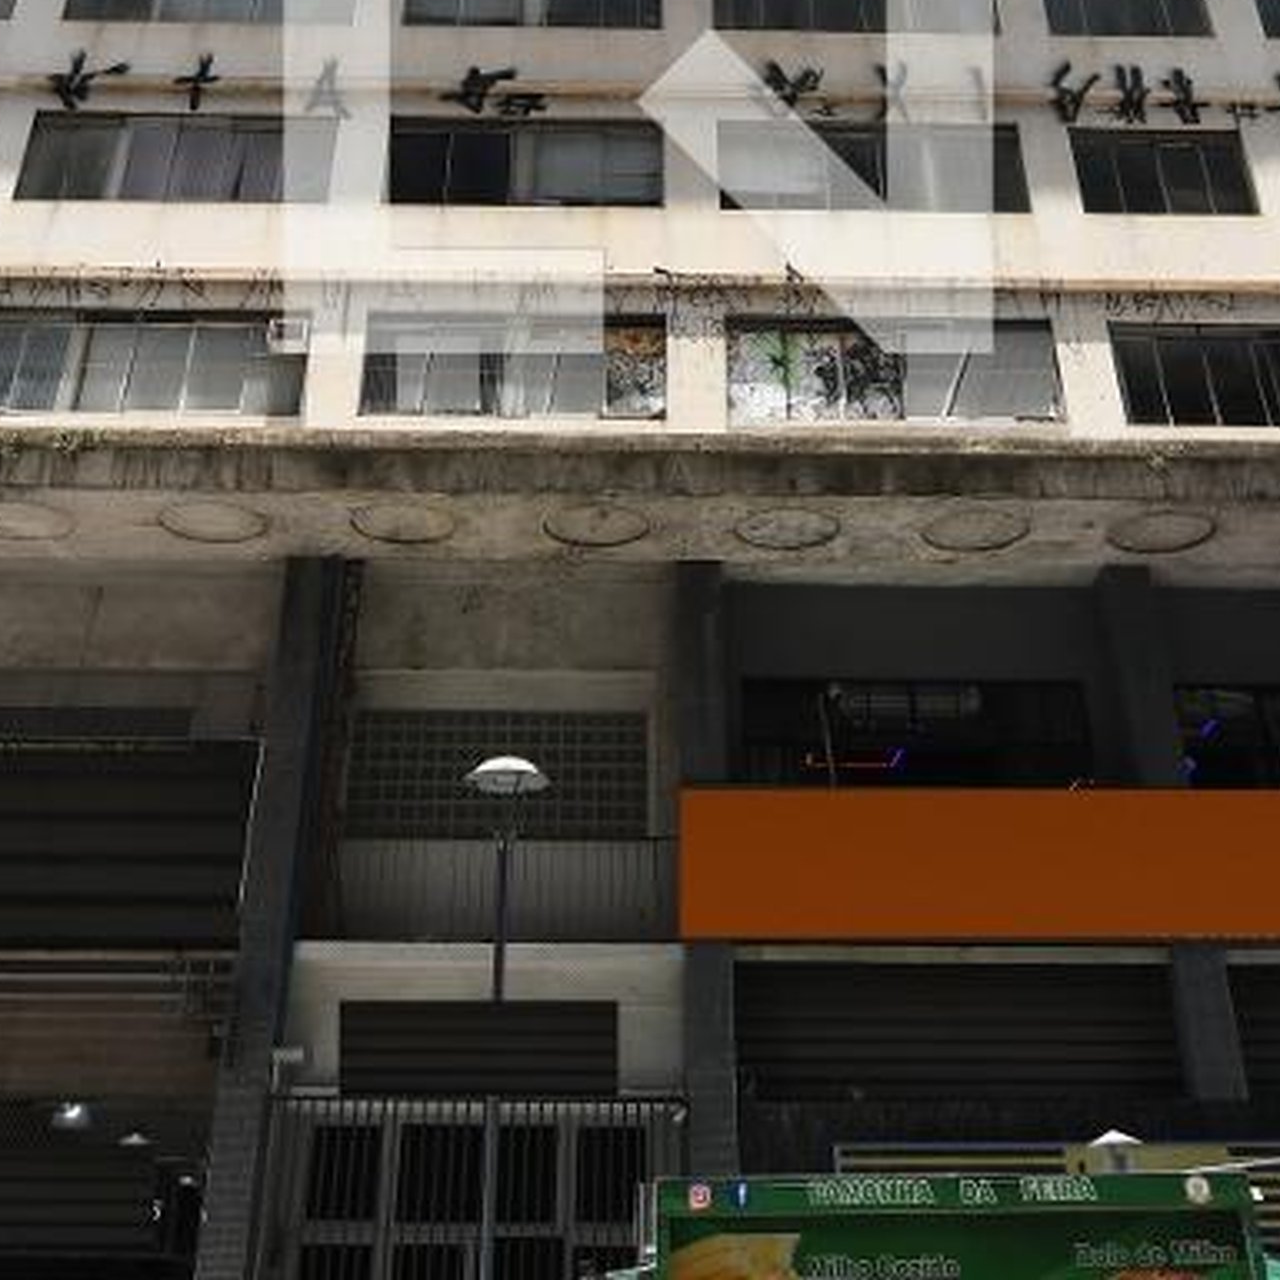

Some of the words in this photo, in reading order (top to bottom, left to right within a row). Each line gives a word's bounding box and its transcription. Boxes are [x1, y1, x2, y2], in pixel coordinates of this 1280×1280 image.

[959, 1178, 998, 1204] DA
[1020, 1174, 1098, 1201] FEIRA
[1134, 1242, 1168, 1267] de
